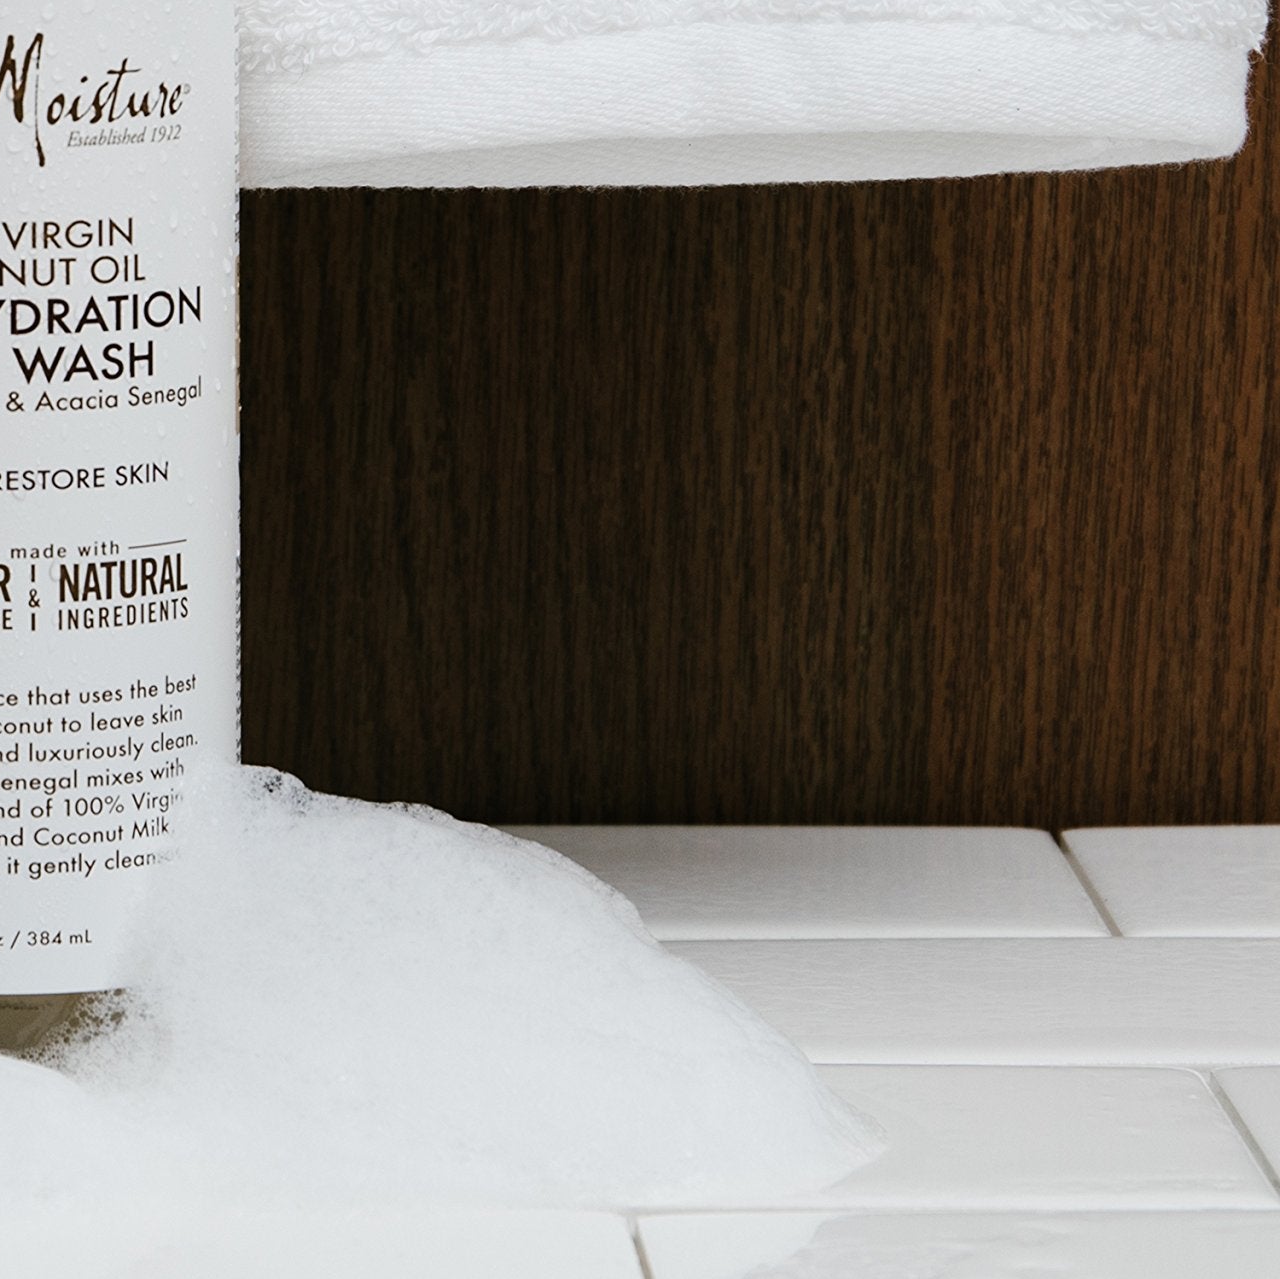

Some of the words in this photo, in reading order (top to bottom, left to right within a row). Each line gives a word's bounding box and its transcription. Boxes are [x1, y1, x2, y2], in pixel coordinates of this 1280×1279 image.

[66, 125, 148, 148] Established
[150, 123, 182, 143] 1912
[1, 217, 133, 251] VIRGIN
[90, 253, 146, 285] OIL
[11, 339, 154, 385] WASH
[5, 391, 25, 413] &
[34, 388, 119, 412] Acacia
[127, 375, 202, 407] Senegal
[115, 460, 169, 486] SKIN
[10, 543, 67, 560] made
[77, 540, 120, 557] with
[28, 588, 41, 609] &
[57, 554, 189, 604] NATURAL
[58, 596, 189, 631] INGREDIENTS
[27, 685, 71, 706] that
[79, 688, 123, 705] uses
[129, 679, 159, 700] the
[165, 673, 197, 695] best
[60, 716, 82, 733] to
[90, 711, 145, 732] leave
[151, 703, 183, 726] skin
[28, 736, 144, 763] luxuriously
[150, 731, 198, 753] clean.
[87, 768, 144, 788] mixes
[150, 757, 184, 780] with
[30, 797, 53, 819] of
[64, 795, 125, 817] 100%
[33, 825, 124, 847] Coconut
[131, 817, 169, 840] Milk
[7, 856, 20, 875] it
[28, 853, 97, 880] gently
[9, 930, 21, 950] /
[27, 930, 63, 947] 384
[69, 928, 93, 945] mL
